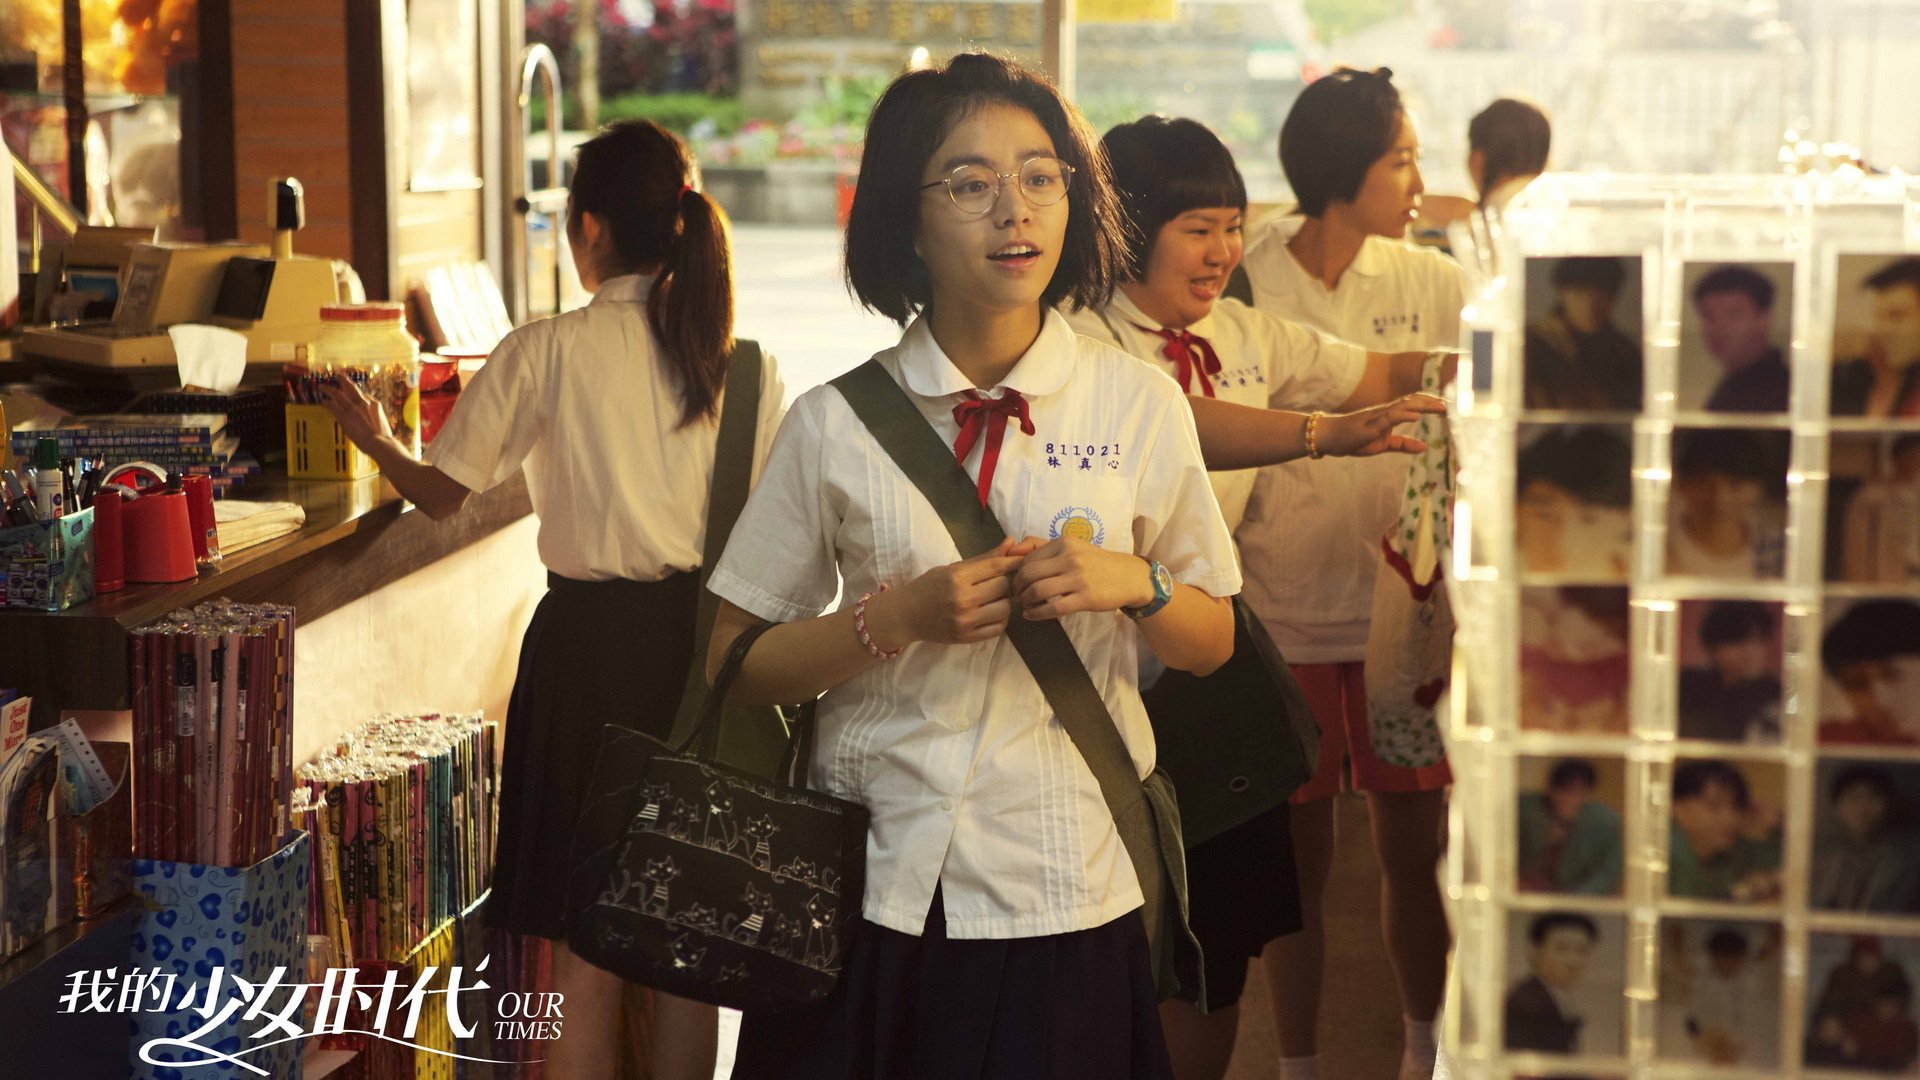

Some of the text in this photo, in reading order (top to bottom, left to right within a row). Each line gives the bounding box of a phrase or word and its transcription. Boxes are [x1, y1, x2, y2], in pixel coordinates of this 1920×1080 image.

[1045, 443, 1121, 456] 811021
[9, 702, 27, 720] Just
[9, 719, 25, 734] One
